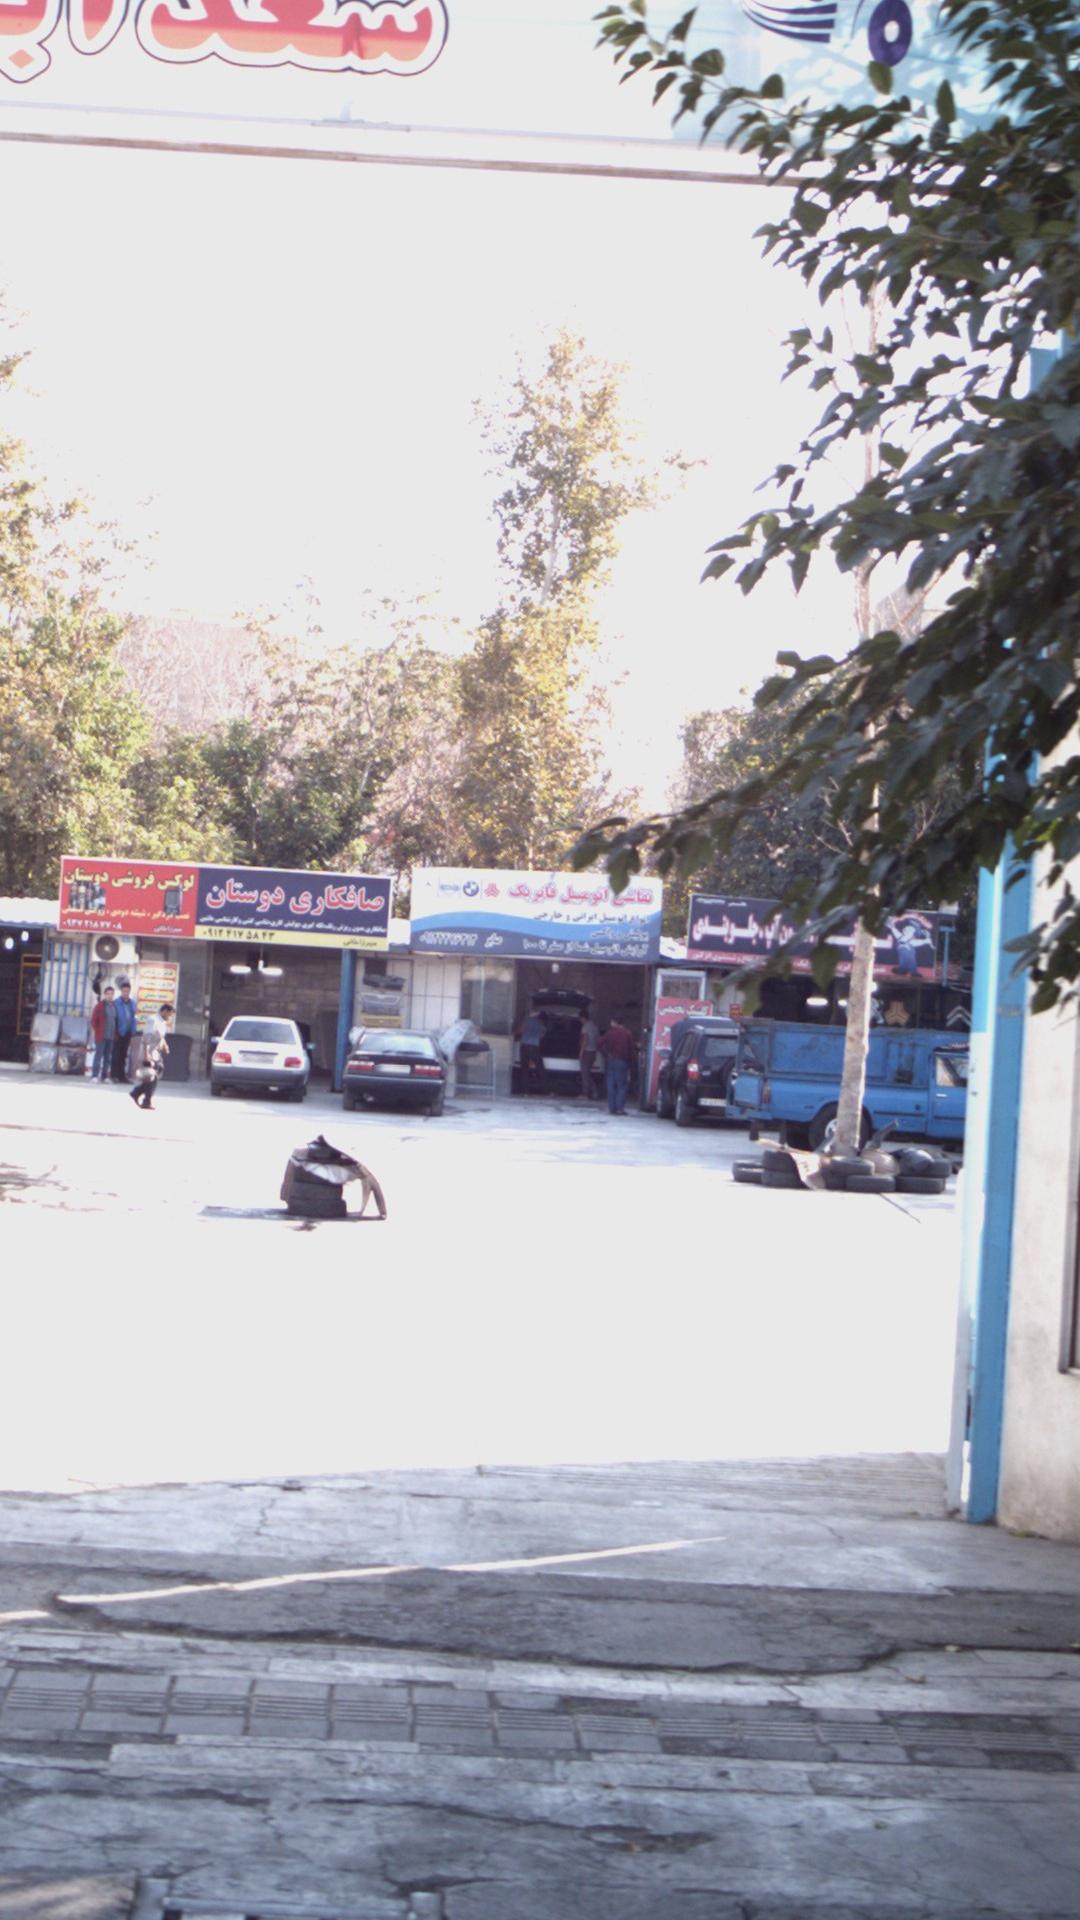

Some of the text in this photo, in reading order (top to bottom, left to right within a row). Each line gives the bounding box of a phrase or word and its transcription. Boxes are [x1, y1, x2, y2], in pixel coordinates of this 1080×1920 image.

[63, 867, 195, 892] لوکس فروشی دوستان
[205, 877, 385, 916] صافکاری دوستان
[560, 886, 609, 906] اتومبیل
